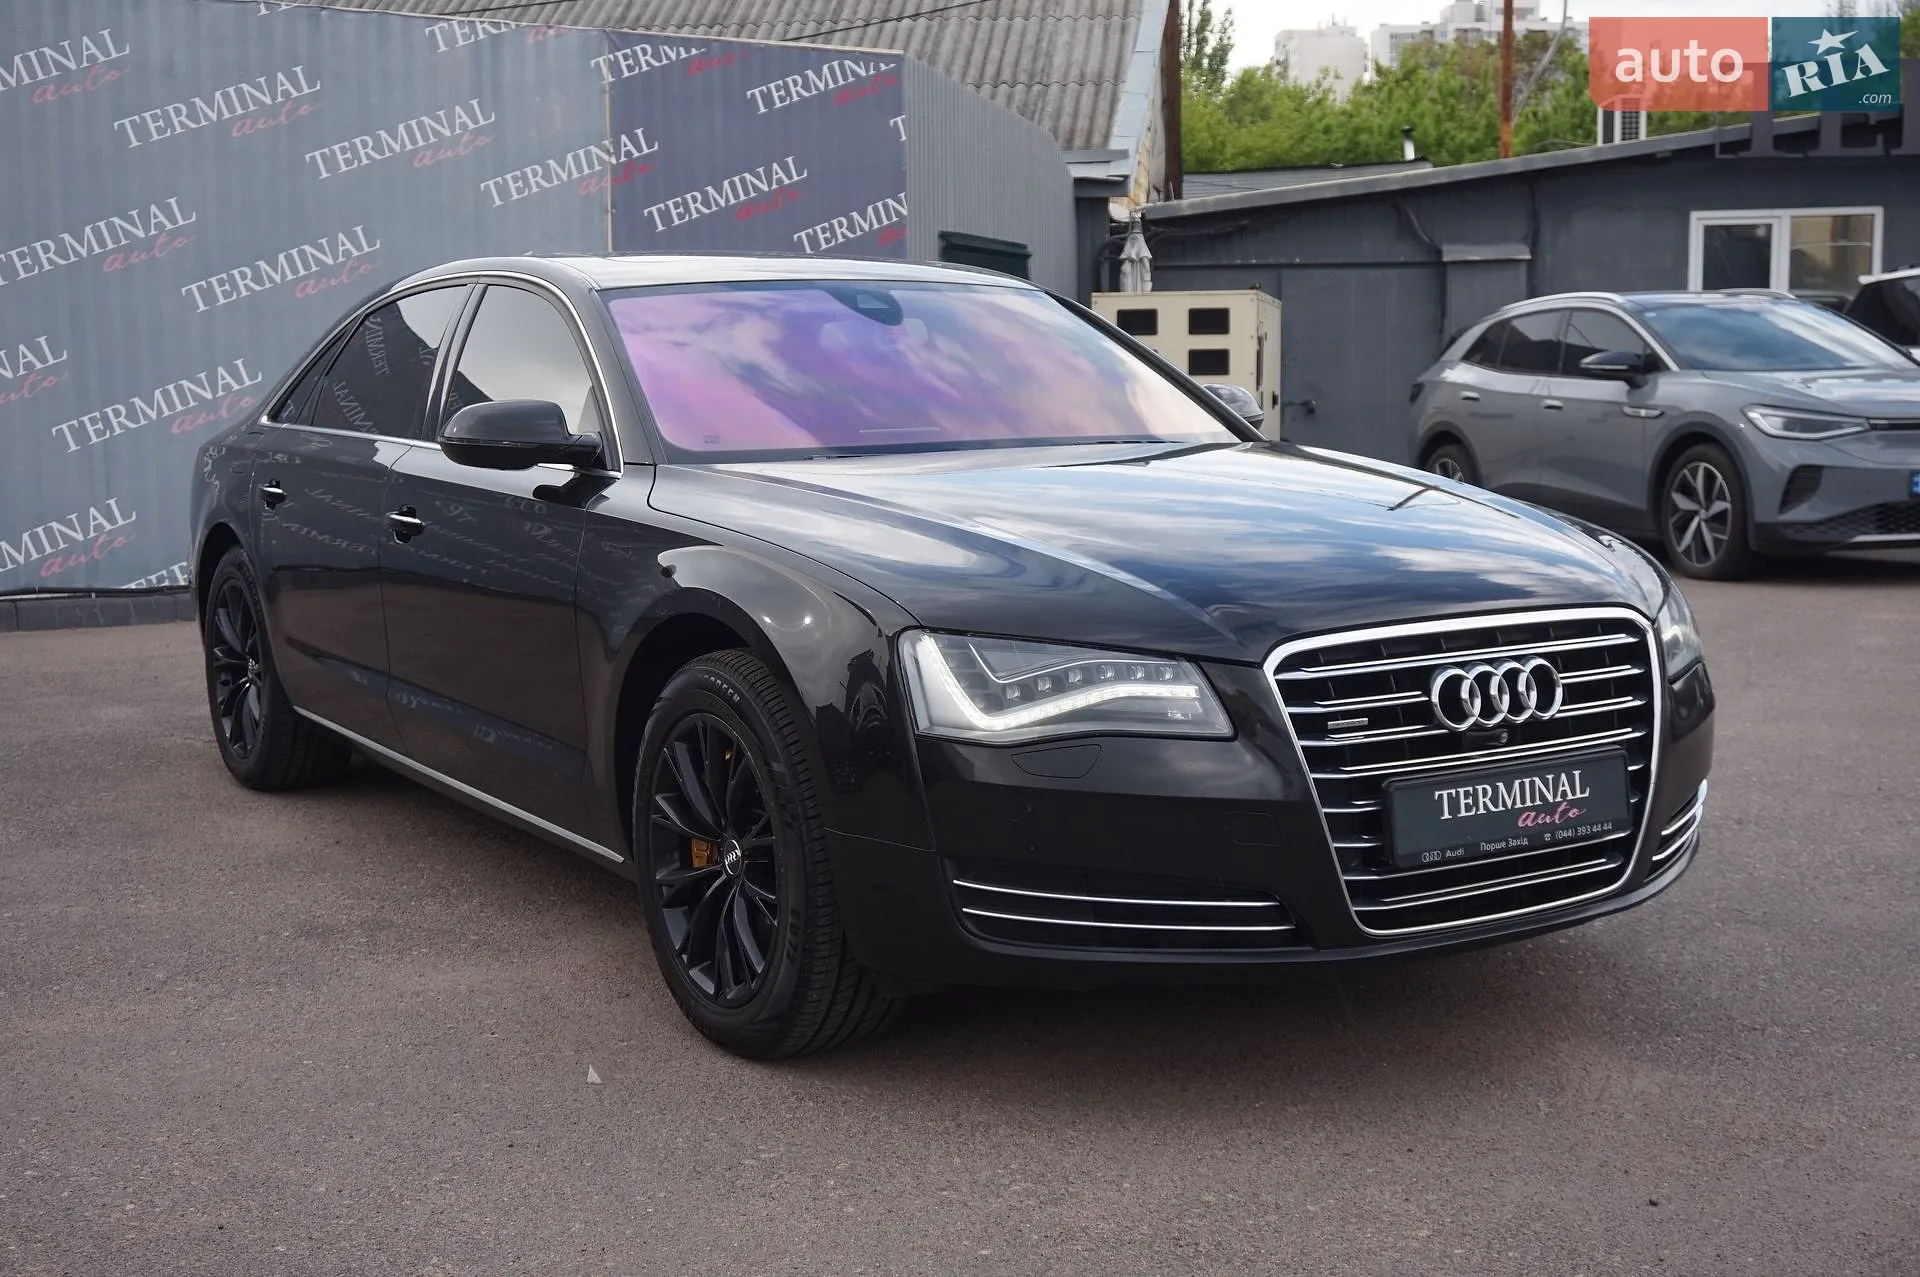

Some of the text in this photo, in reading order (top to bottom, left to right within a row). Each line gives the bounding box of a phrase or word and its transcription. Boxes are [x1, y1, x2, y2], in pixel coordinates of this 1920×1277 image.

[425, 20, 525, 53] TER
[590, 43, 706, 84] TERM
[32, 64, 130, 104] auto
[747, 59, 897, 114] TERMIN
[113, 64, 321, 149] TERMINAL
[231, 100, 321, 138] auto
[304, 98, 495, 179] TERMINAL
[412, 132, 495, 168] auto
[480, 127, 659, 208] TERMINAL
[644, 155, 807, 233] TERMINAL
[735, 187, 803, 222] auto
[102, 233, 197, 273] auto
[181, 224, 381, 313] TERMINAL
[294, 259, 381, 298] auto
[52, 358, 262, 453] TERMINAL
[171, 393, 260, 434] auto
[40, 533, 136, 578] auto
[1434, 770, 1590, 820] TERMINAL
[1517, 801, 1586, 828] auto
[1480, 837, 1529, 852] Порше Захід
[1555, 820, 1613, 840] (044) 393 44 44
[1446, 848, 1464, 858] Audi
